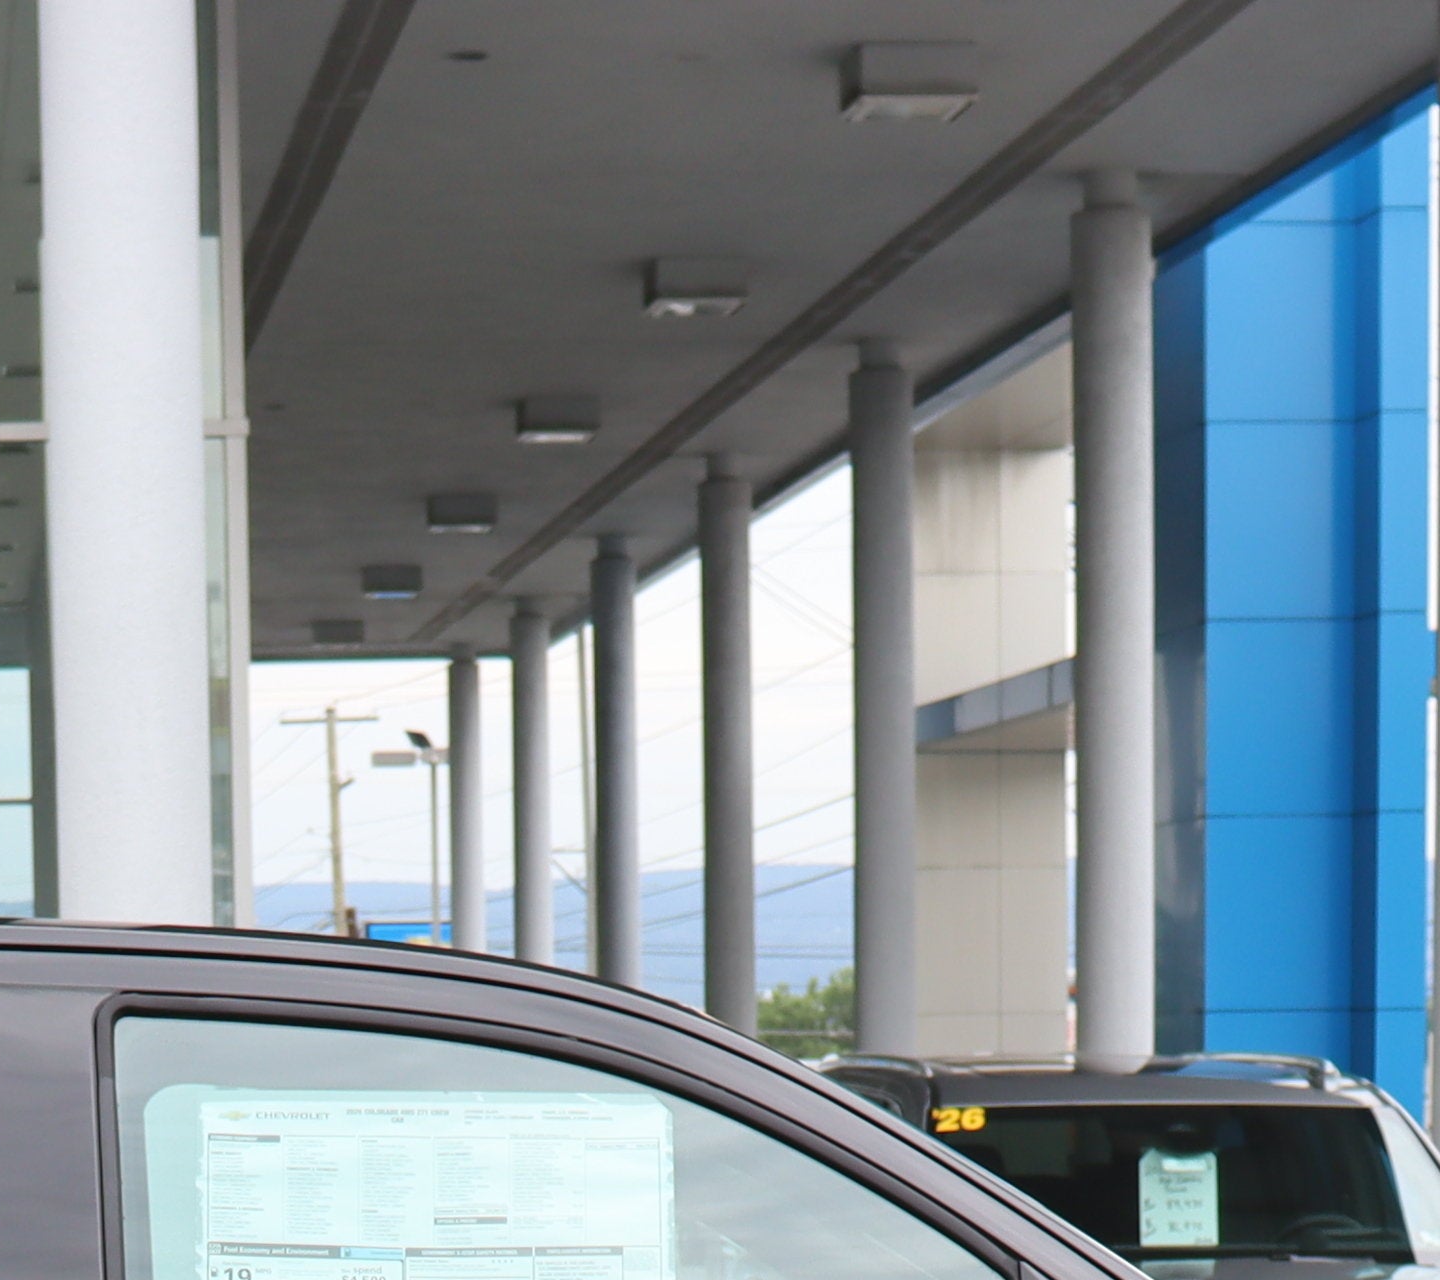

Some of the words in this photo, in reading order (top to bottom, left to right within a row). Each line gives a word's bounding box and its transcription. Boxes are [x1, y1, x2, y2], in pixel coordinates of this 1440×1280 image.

[255, 1111, 331, 1121] CHEVROLET
[931, 1106, 986, 1133] '26
[353, 1265, 383, 1275] spend
